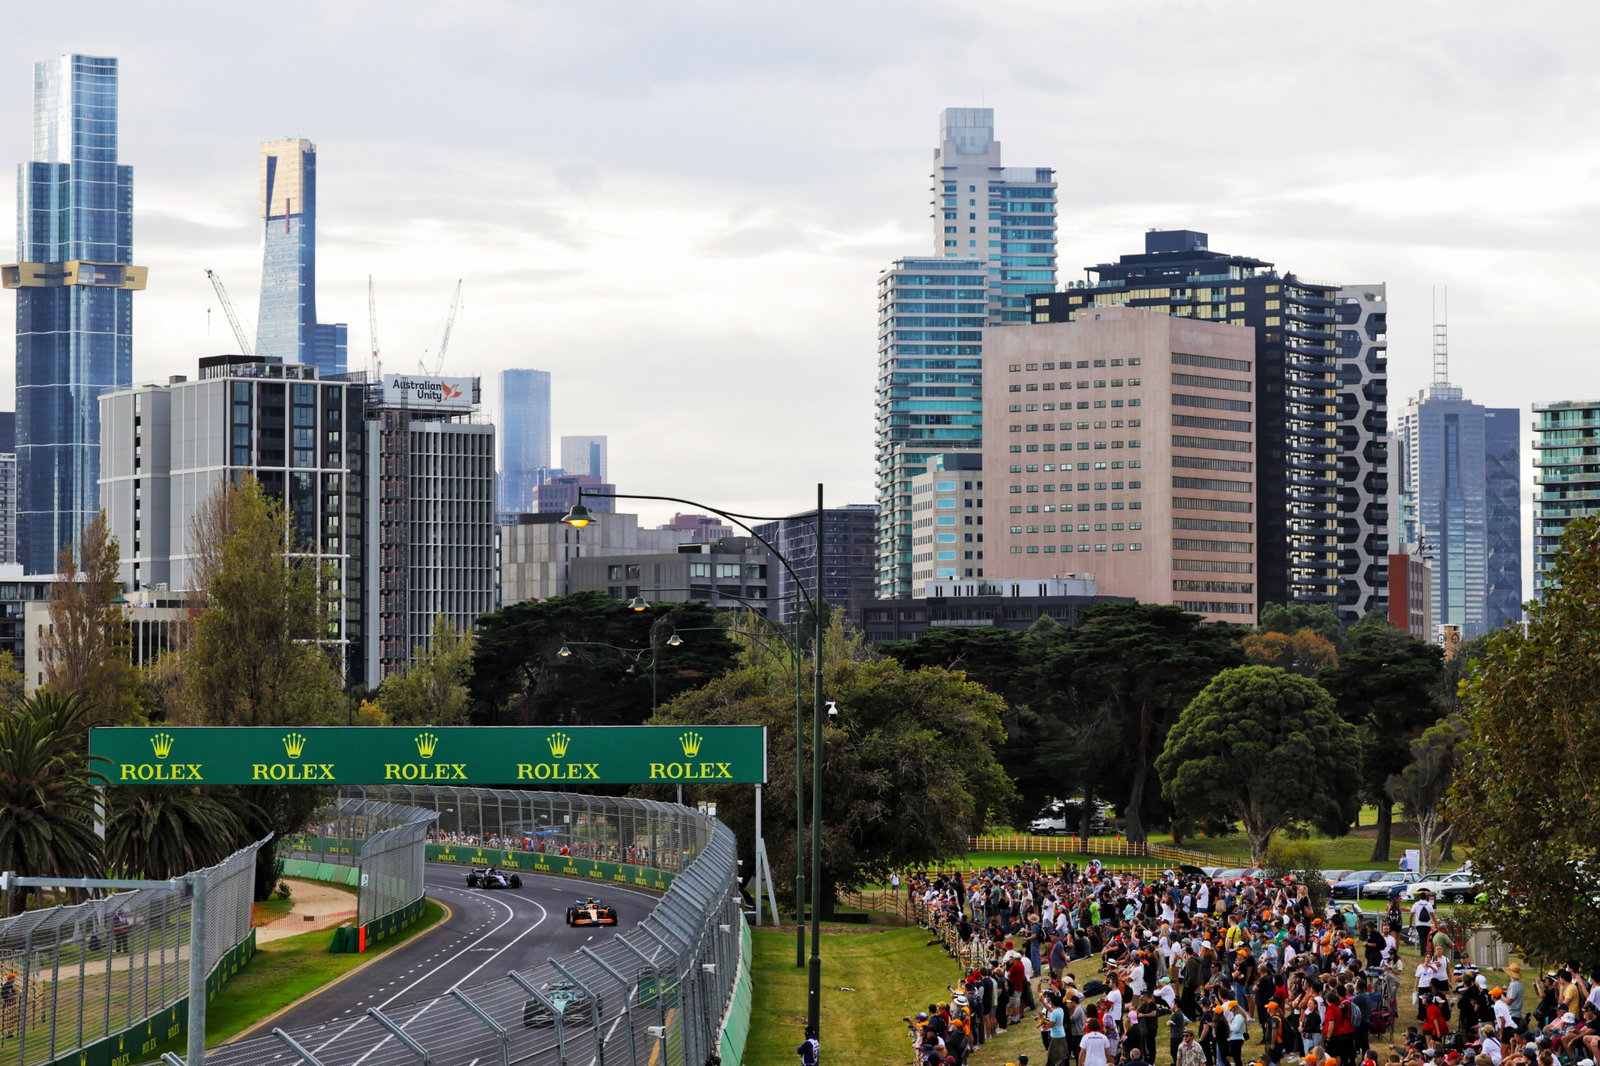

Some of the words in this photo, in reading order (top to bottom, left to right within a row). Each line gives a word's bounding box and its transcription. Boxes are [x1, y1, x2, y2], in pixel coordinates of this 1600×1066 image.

[393, 379, 442, 390] Australian
[417, 390, 442, 402] Unity
[119, 763, 204, 782] ROLEX
[252, 763, 335, 781] ROLEX
[384, 763, 467, 780] ROLEX
[517, 763, 600, 780] ROLEX
[649, 762, 733, 779] ROLEX
[142, 1037, 157, 1055] ROLEX
